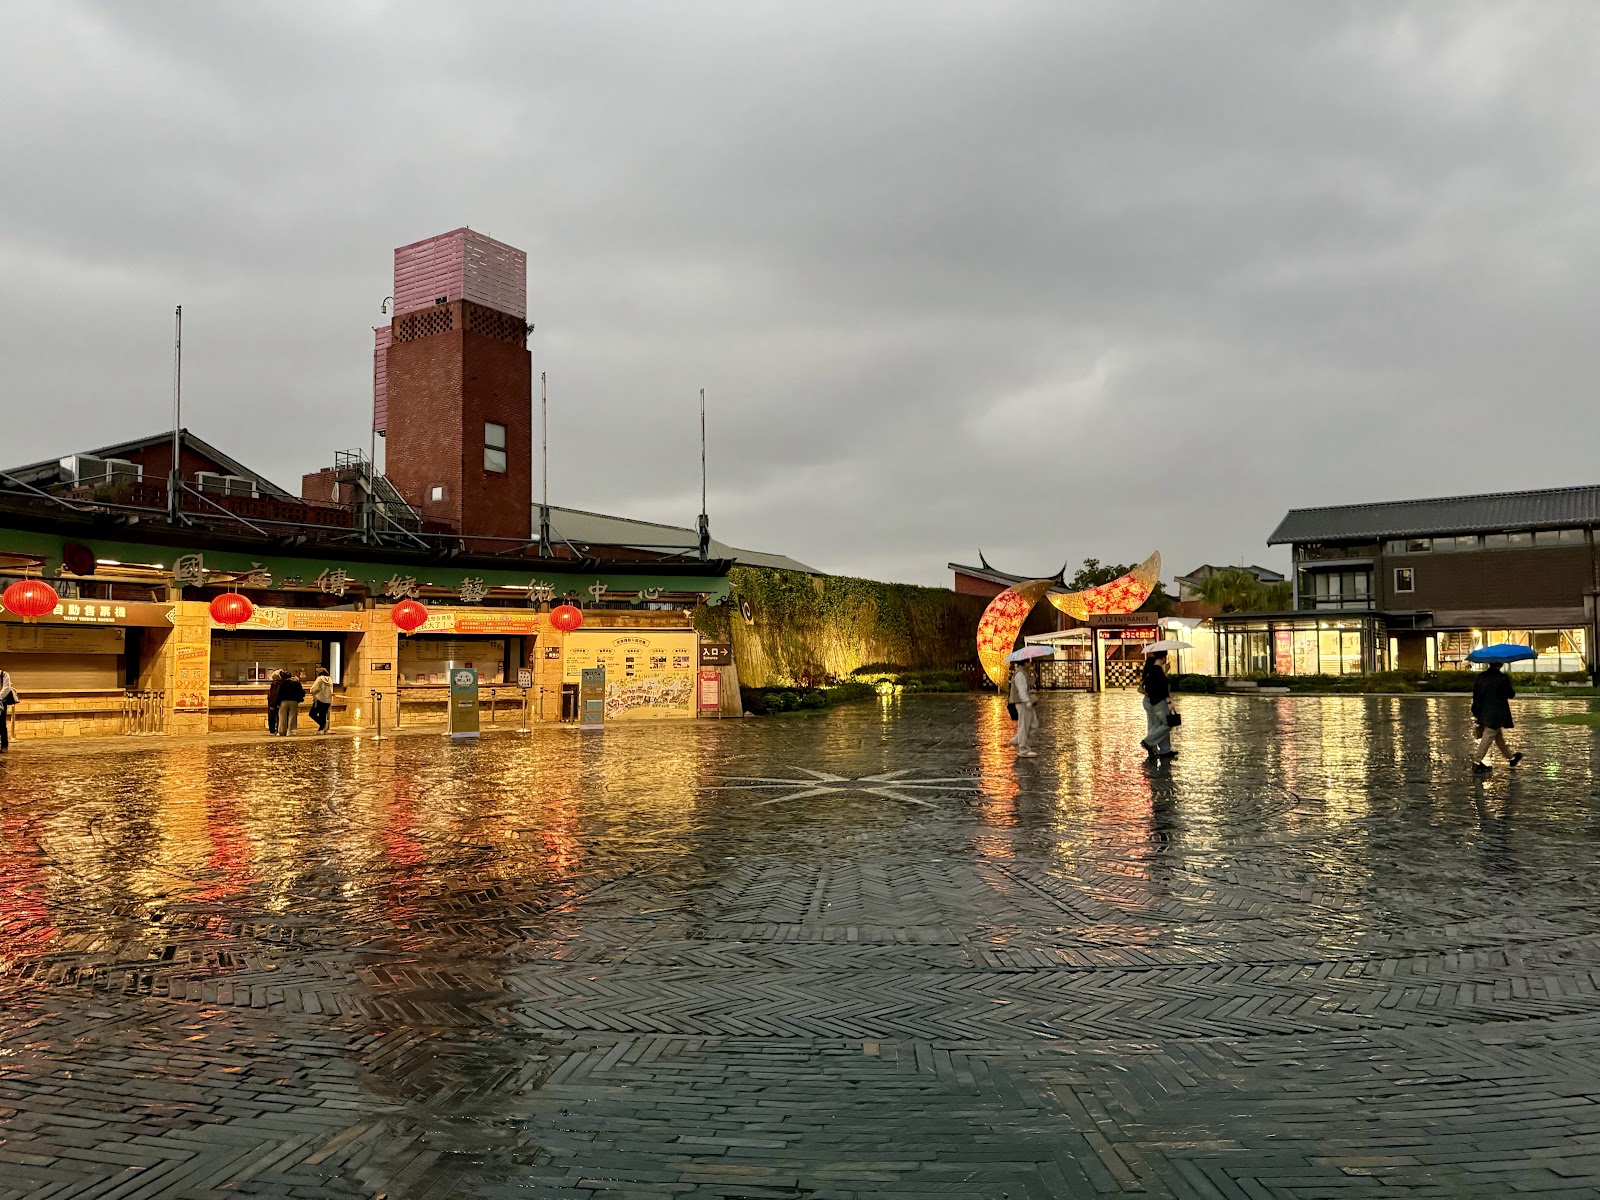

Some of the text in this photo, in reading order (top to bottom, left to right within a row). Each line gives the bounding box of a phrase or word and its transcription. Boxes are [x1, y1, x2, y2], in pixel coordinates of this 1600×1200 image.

[53, 603, 126, 618] 自動售票機
[1115, 615, 1149, 623] ENTRANCE
[115, 630, 122, 641] 2
[314, 641, 321, 651] 4
[703, 648, 719, 656] 入口
